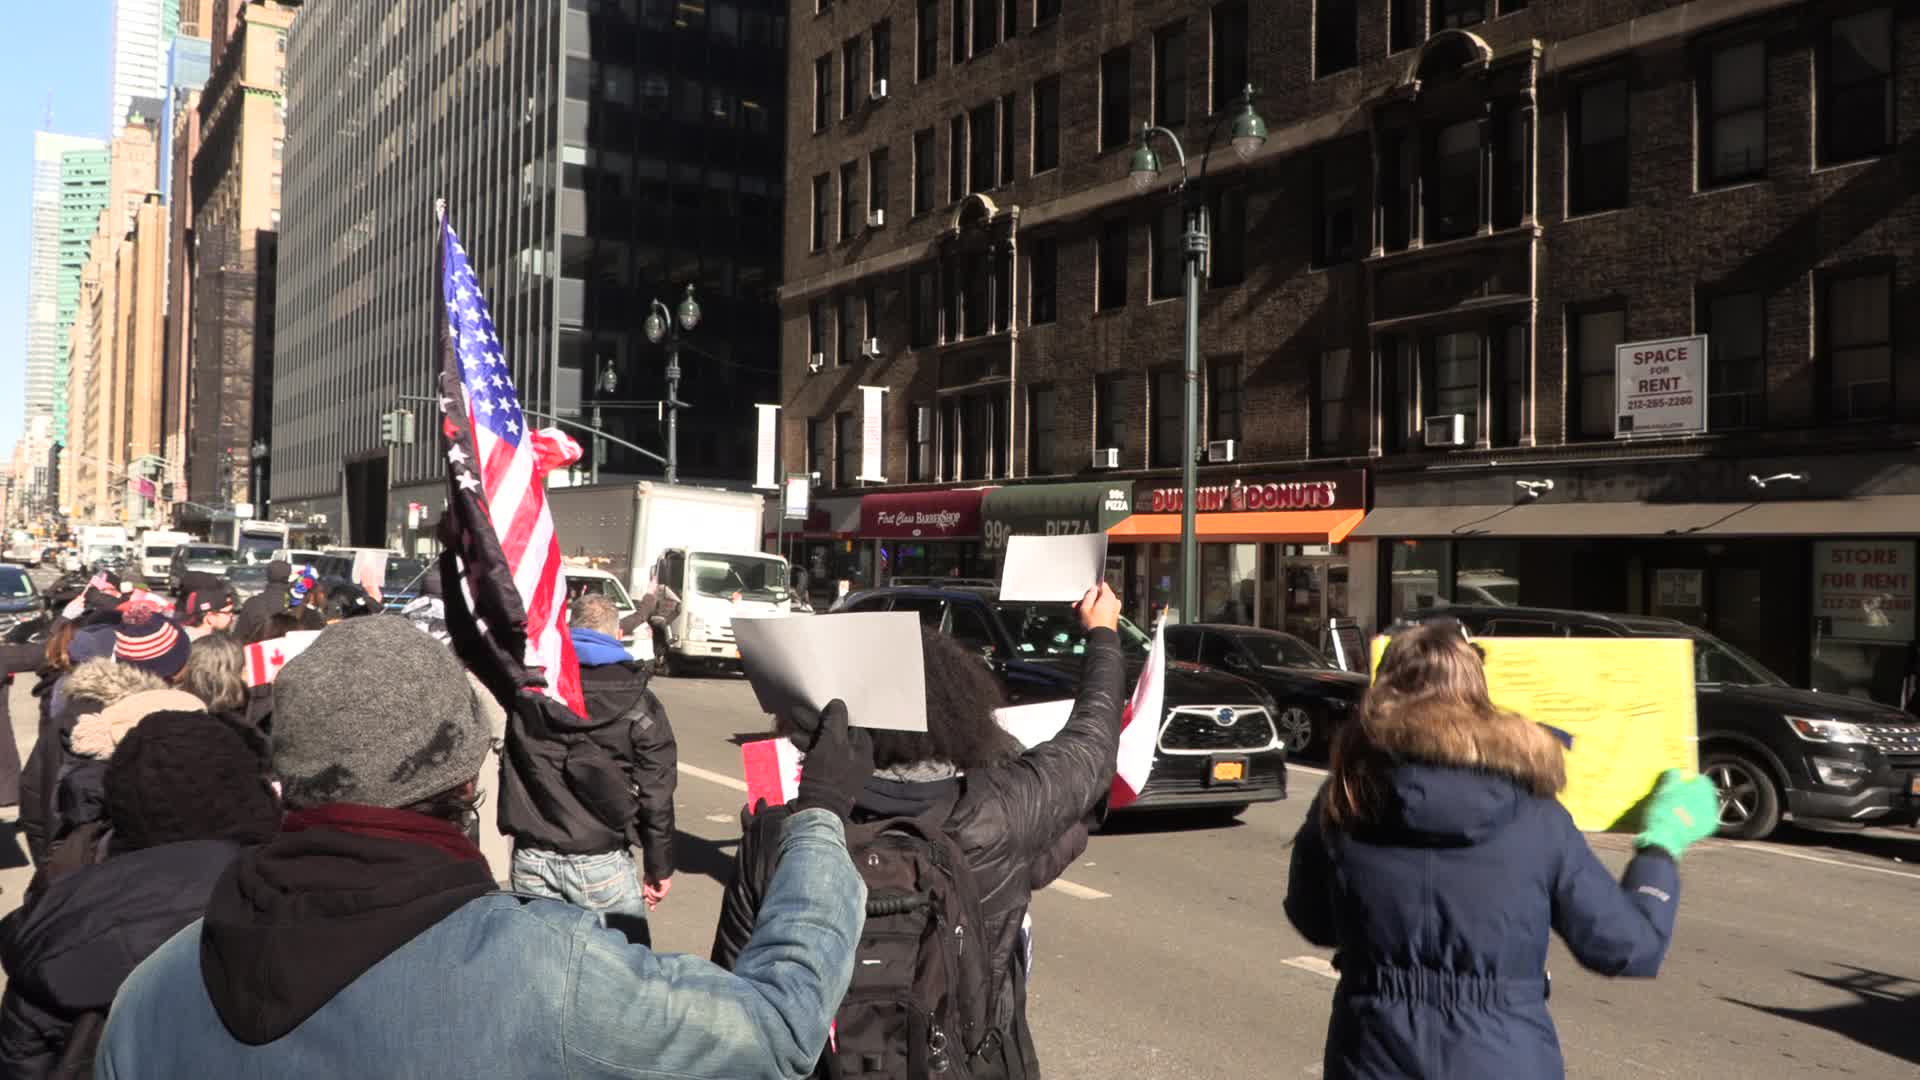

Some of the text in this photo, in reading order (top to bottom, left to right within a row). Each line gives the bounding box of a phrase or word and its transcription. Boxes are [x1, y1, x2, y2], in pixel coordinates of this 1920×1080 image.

[1633, 347, 1688, 365] SPACE
[1650, 366, 1669, 375] FOR
[1639, 377, 1681, 392] RENT
[1247, 482, 1335, 508] DONUTS
[1105, 500, 1128, 511] PIZZA
[1832, 549, 1896, 564] STORE
[1820, 573, 1911, 589] FOR RENT
